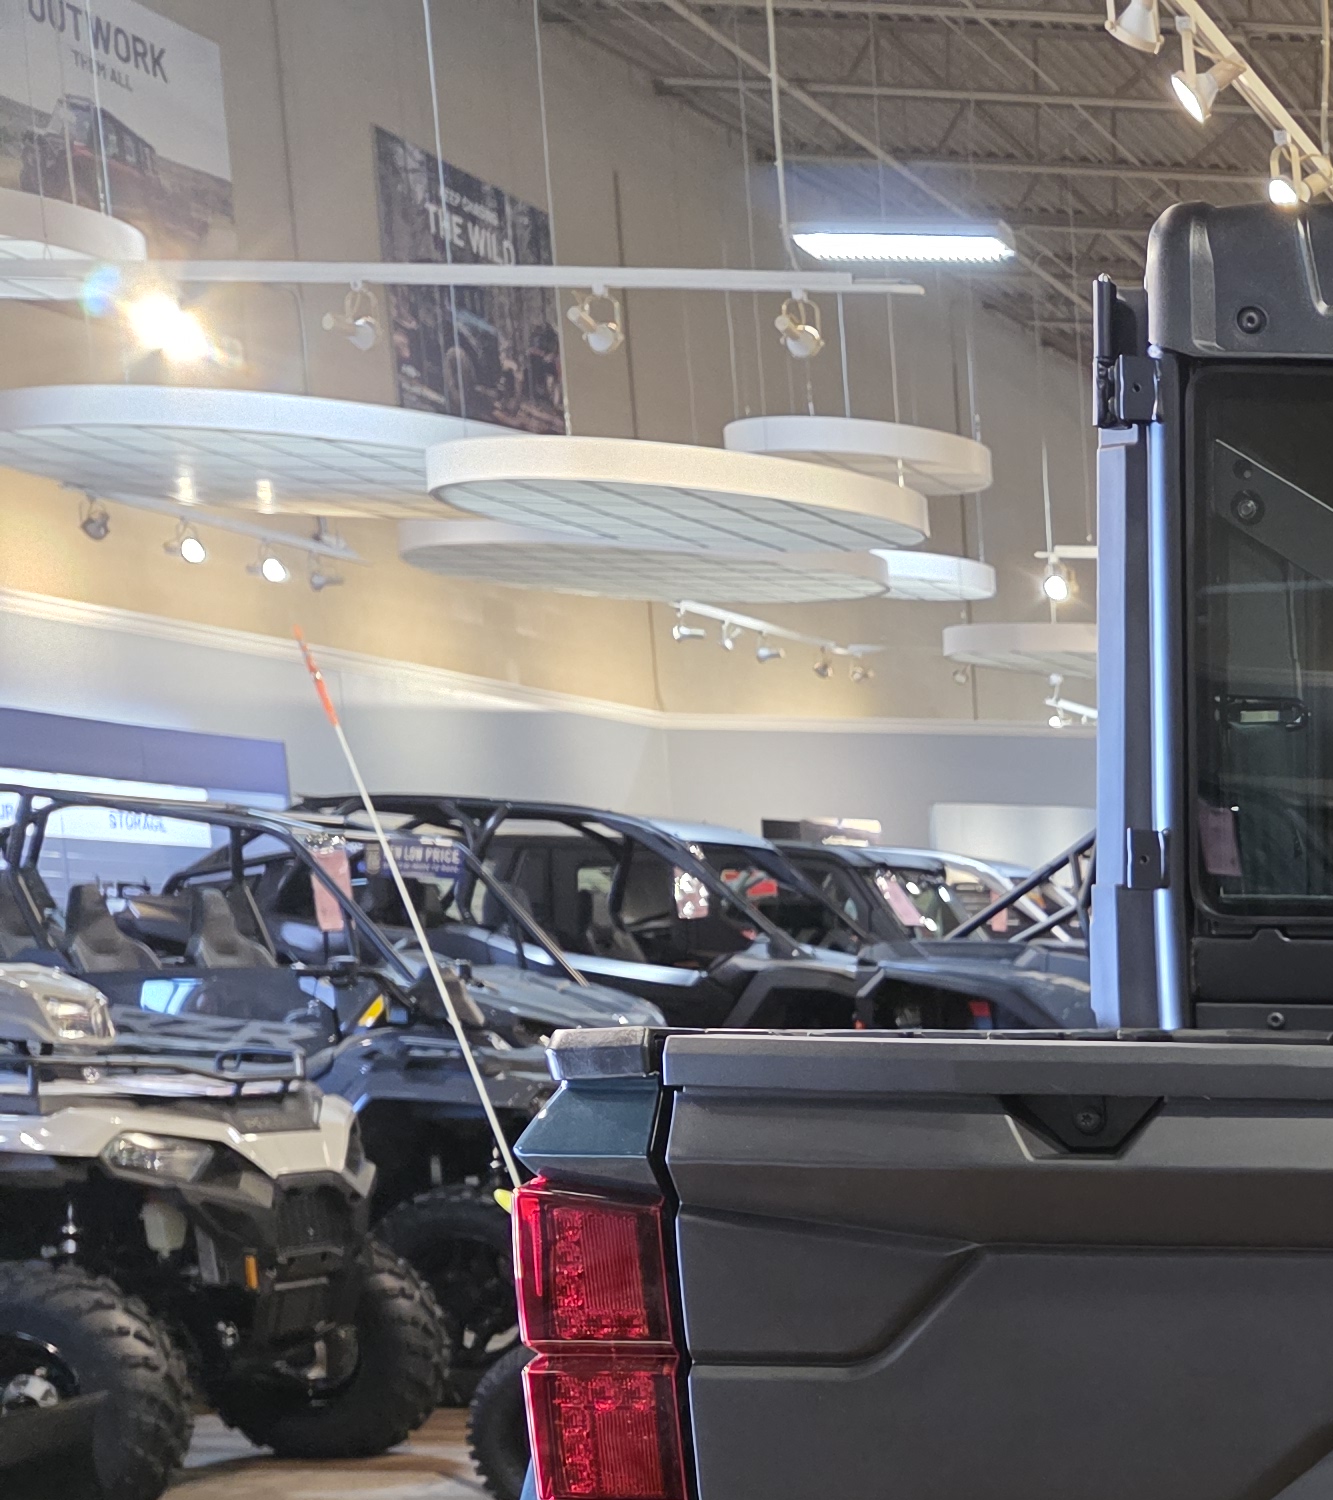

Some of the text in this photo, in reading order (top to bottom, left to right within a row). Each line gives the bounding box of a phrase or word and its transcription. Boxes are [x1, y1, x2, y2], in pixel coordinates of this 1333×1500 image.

[110, 68, 133, 92] ALL
[424, 202, 516, 265] THE WILD
[109, 811, 167, 833] STORAGE
[404, 846, 423, 861] LOW
[425, 847, 460, 865] PRICE
